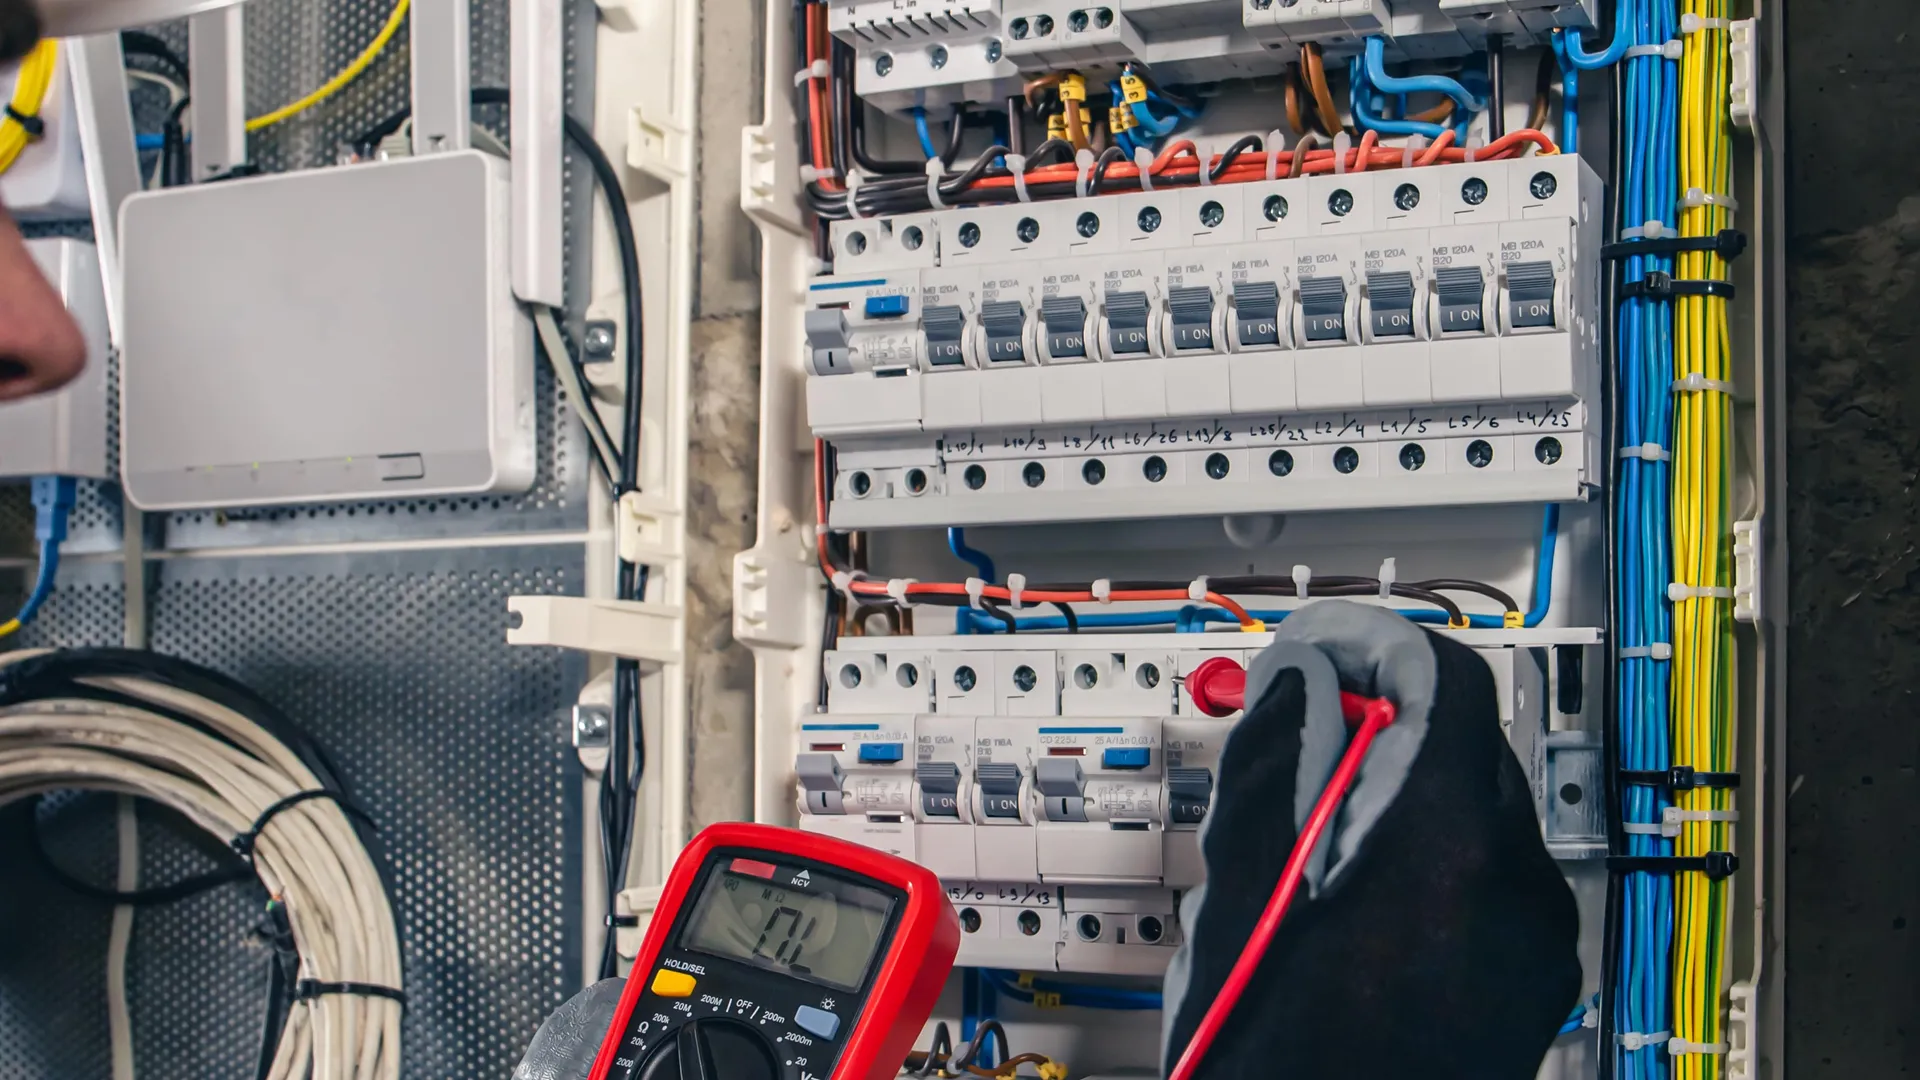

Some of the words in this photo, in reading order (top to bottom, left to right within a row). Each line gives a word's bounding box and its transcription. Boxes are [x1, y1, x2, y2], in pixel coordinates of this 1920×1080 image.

[1433, 246, 1448, 256] MB
[1451, 245, 1475, 254] 120A
[1501, 242, 1517, 251] MB
[1520, 240, 1544, 250] 120A
[1364, 250, 1380, 259] MB
[1384, 248, 1406, 258] 120A
[1501, 251, 1521, 261] B20
[1364, 259, 1384, 269] B20
[1433, 256, 1452, 265] B20
[1461, 309, 1480, 321] ON
[1530, 304, 1550, 317] ON
[1324, 319, 1342, 330] ON
[1391, 315, 1410, 327] ON
[1193, 328, 1210, 340] ON
[1258, 323, 1276, 334] ON
[1066, 337, 1083, 348] ON
[1129, 332, 1147, 343] ON
[1005, 342, 1021, 352] ON
[1448, 415, 1499, 430] L5/6
[1516, 408, 1572, 428] L4/25
[1315, 418, 1365, 438] L2/4
[1381, 417, 1432, 436] L1/5
[1064, 432, 1115, 451] L8/11
[1124, 428, 1178, 446] L6/26
[1040, 736, 1052, 744] CD
[1094, 736, 1105, 745] 25
[1001, 800, 1017, 810] ON
[1193, 805, 1209, 815] ON
[791, 877, 811, 888] NCV
[761, 888, 772, 900] M
[664, 957, 706, 976] HOLD/SEL
[700, 994, 723, 1006] 200M
[736, 999, 753, 1010] OFF
[673, 1001, 692, 1012] 20M
[652, 1012, 670, 1024] 200k
[763, 1010, 786, 1024] 200m
[637, 1021, 650, 1034] Ω
[630, 1036, 644, 1047] 20k
[784, 1031, 813, 1047] 2000m
[616, 1057, 634, 1068] 2000
[795, 1056, 808, 1066] 20
